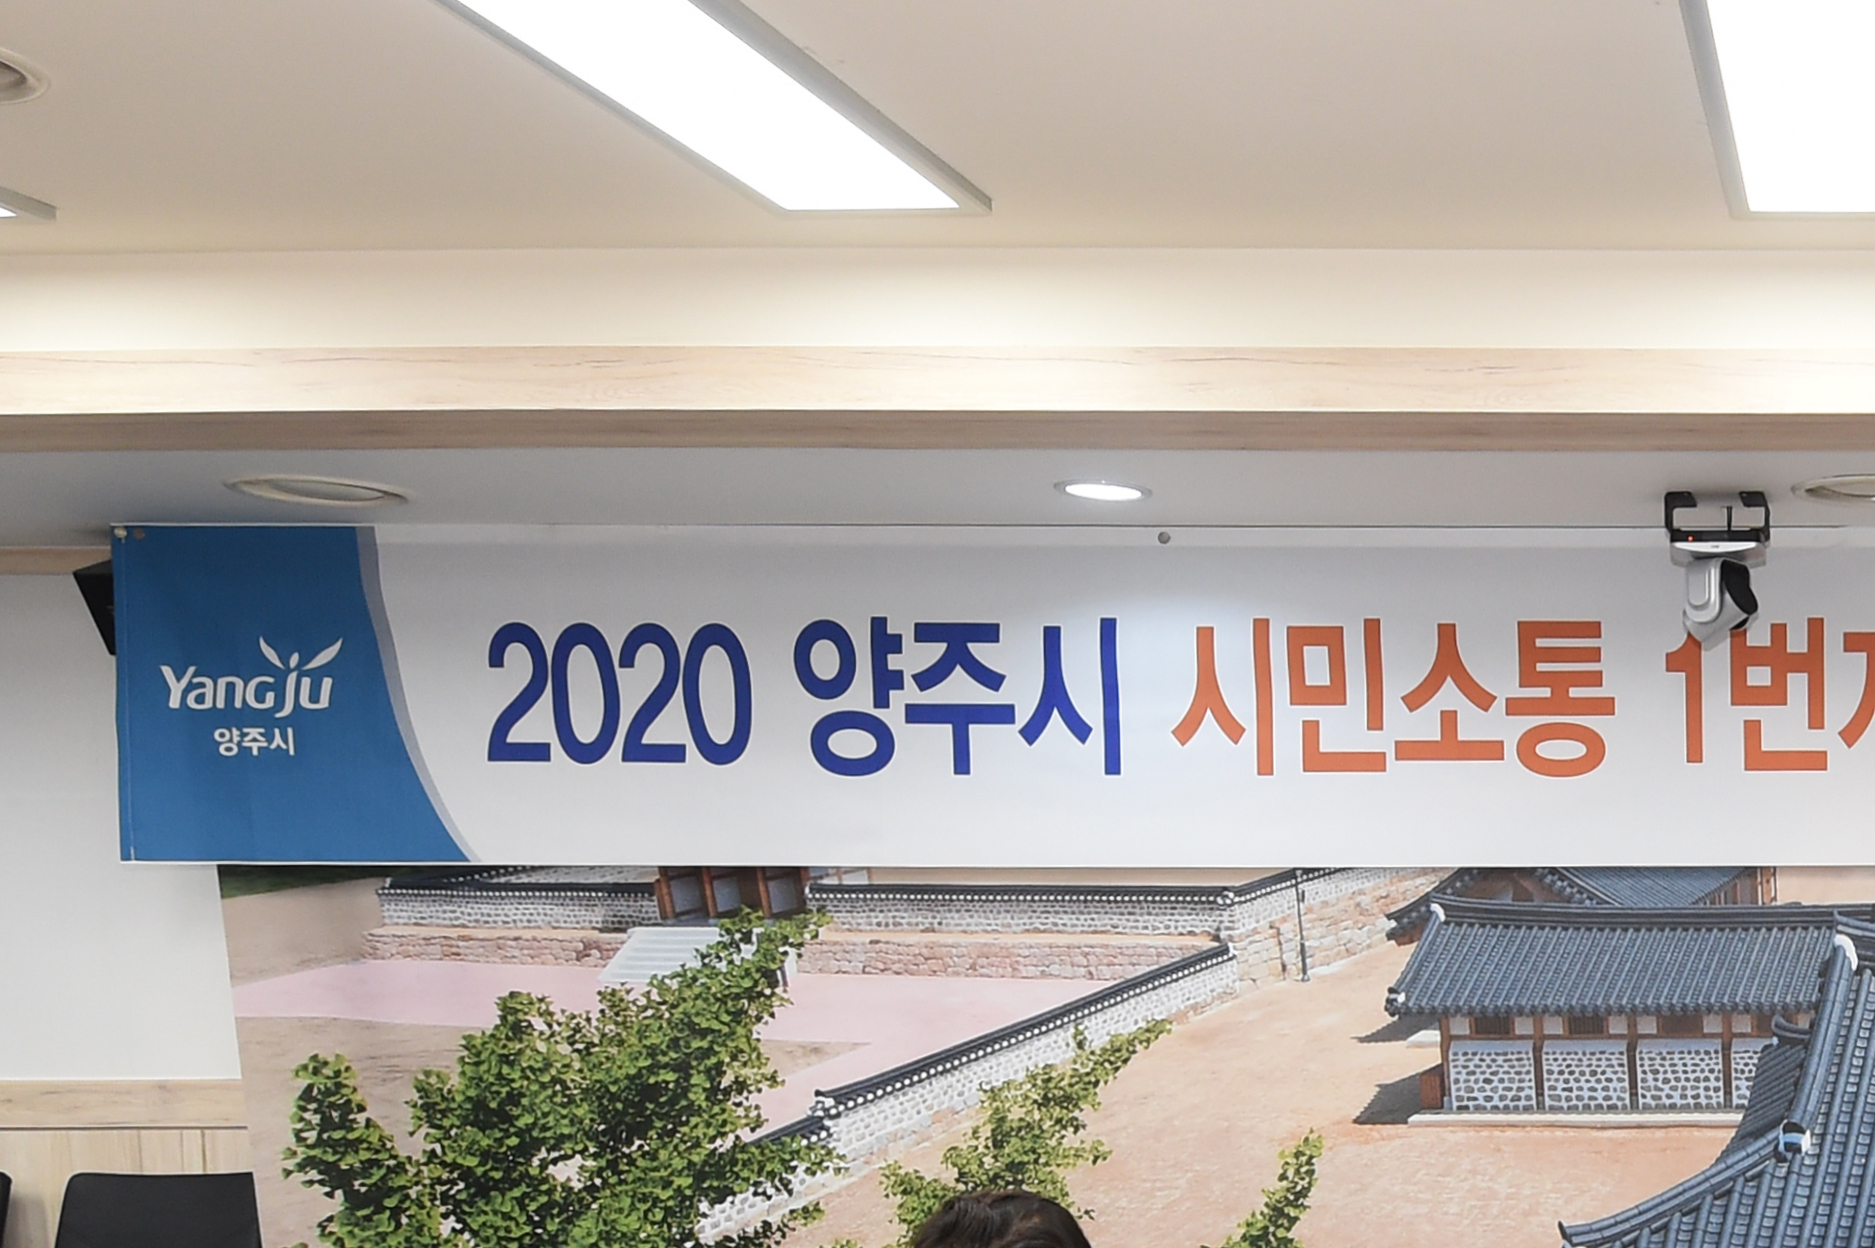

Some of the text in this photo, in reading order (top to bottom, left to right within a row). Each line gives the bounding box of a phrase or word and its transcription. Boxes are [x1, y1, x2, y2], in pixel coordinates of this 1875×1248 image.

[213, 726, 297, 757] 양주시
[488, 622, 752, 764] 2020
[794, 617, 1122, 776] 양주시
[1172, 617, 1616, 778] 시민소통
